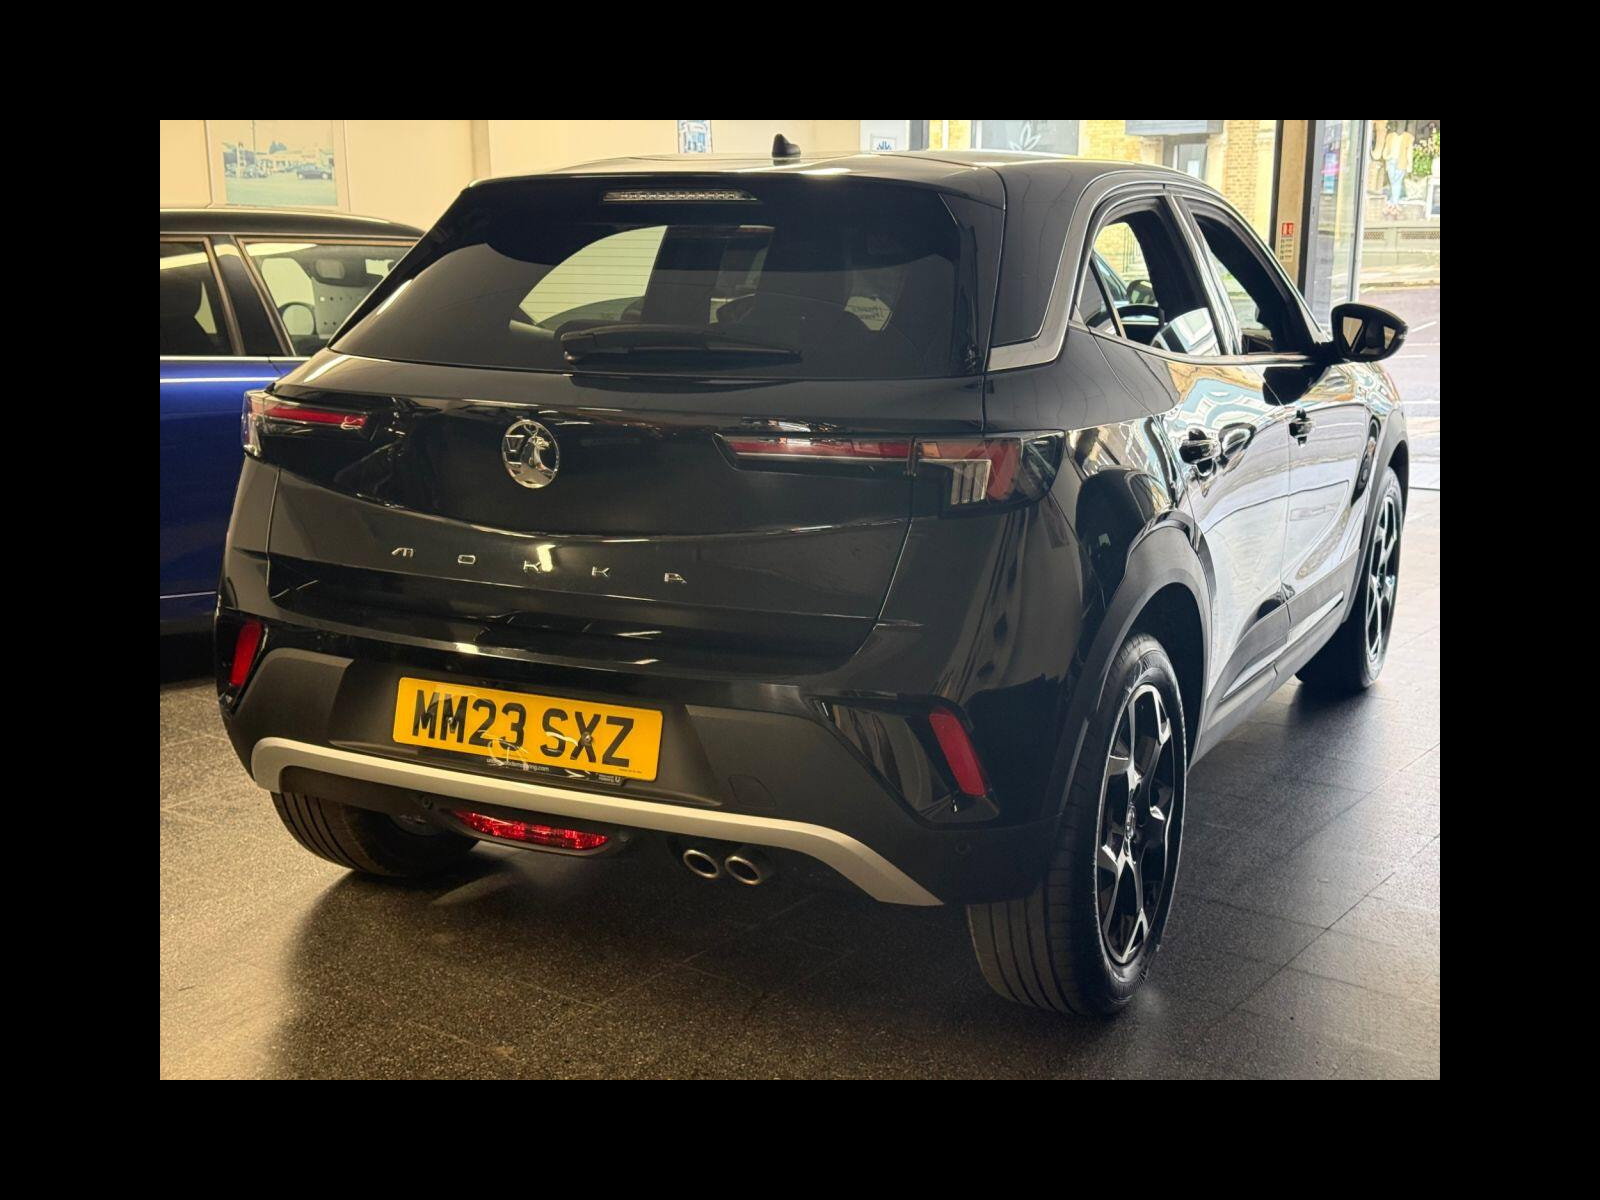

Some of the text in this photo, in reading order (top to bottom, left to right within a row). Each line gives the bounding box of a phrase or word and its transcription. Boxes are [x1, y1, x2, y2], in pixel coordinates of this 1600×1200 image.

[392, 547, 687, 584] MOKKA
[412, 689, 634, 767] MM23 SXZ
